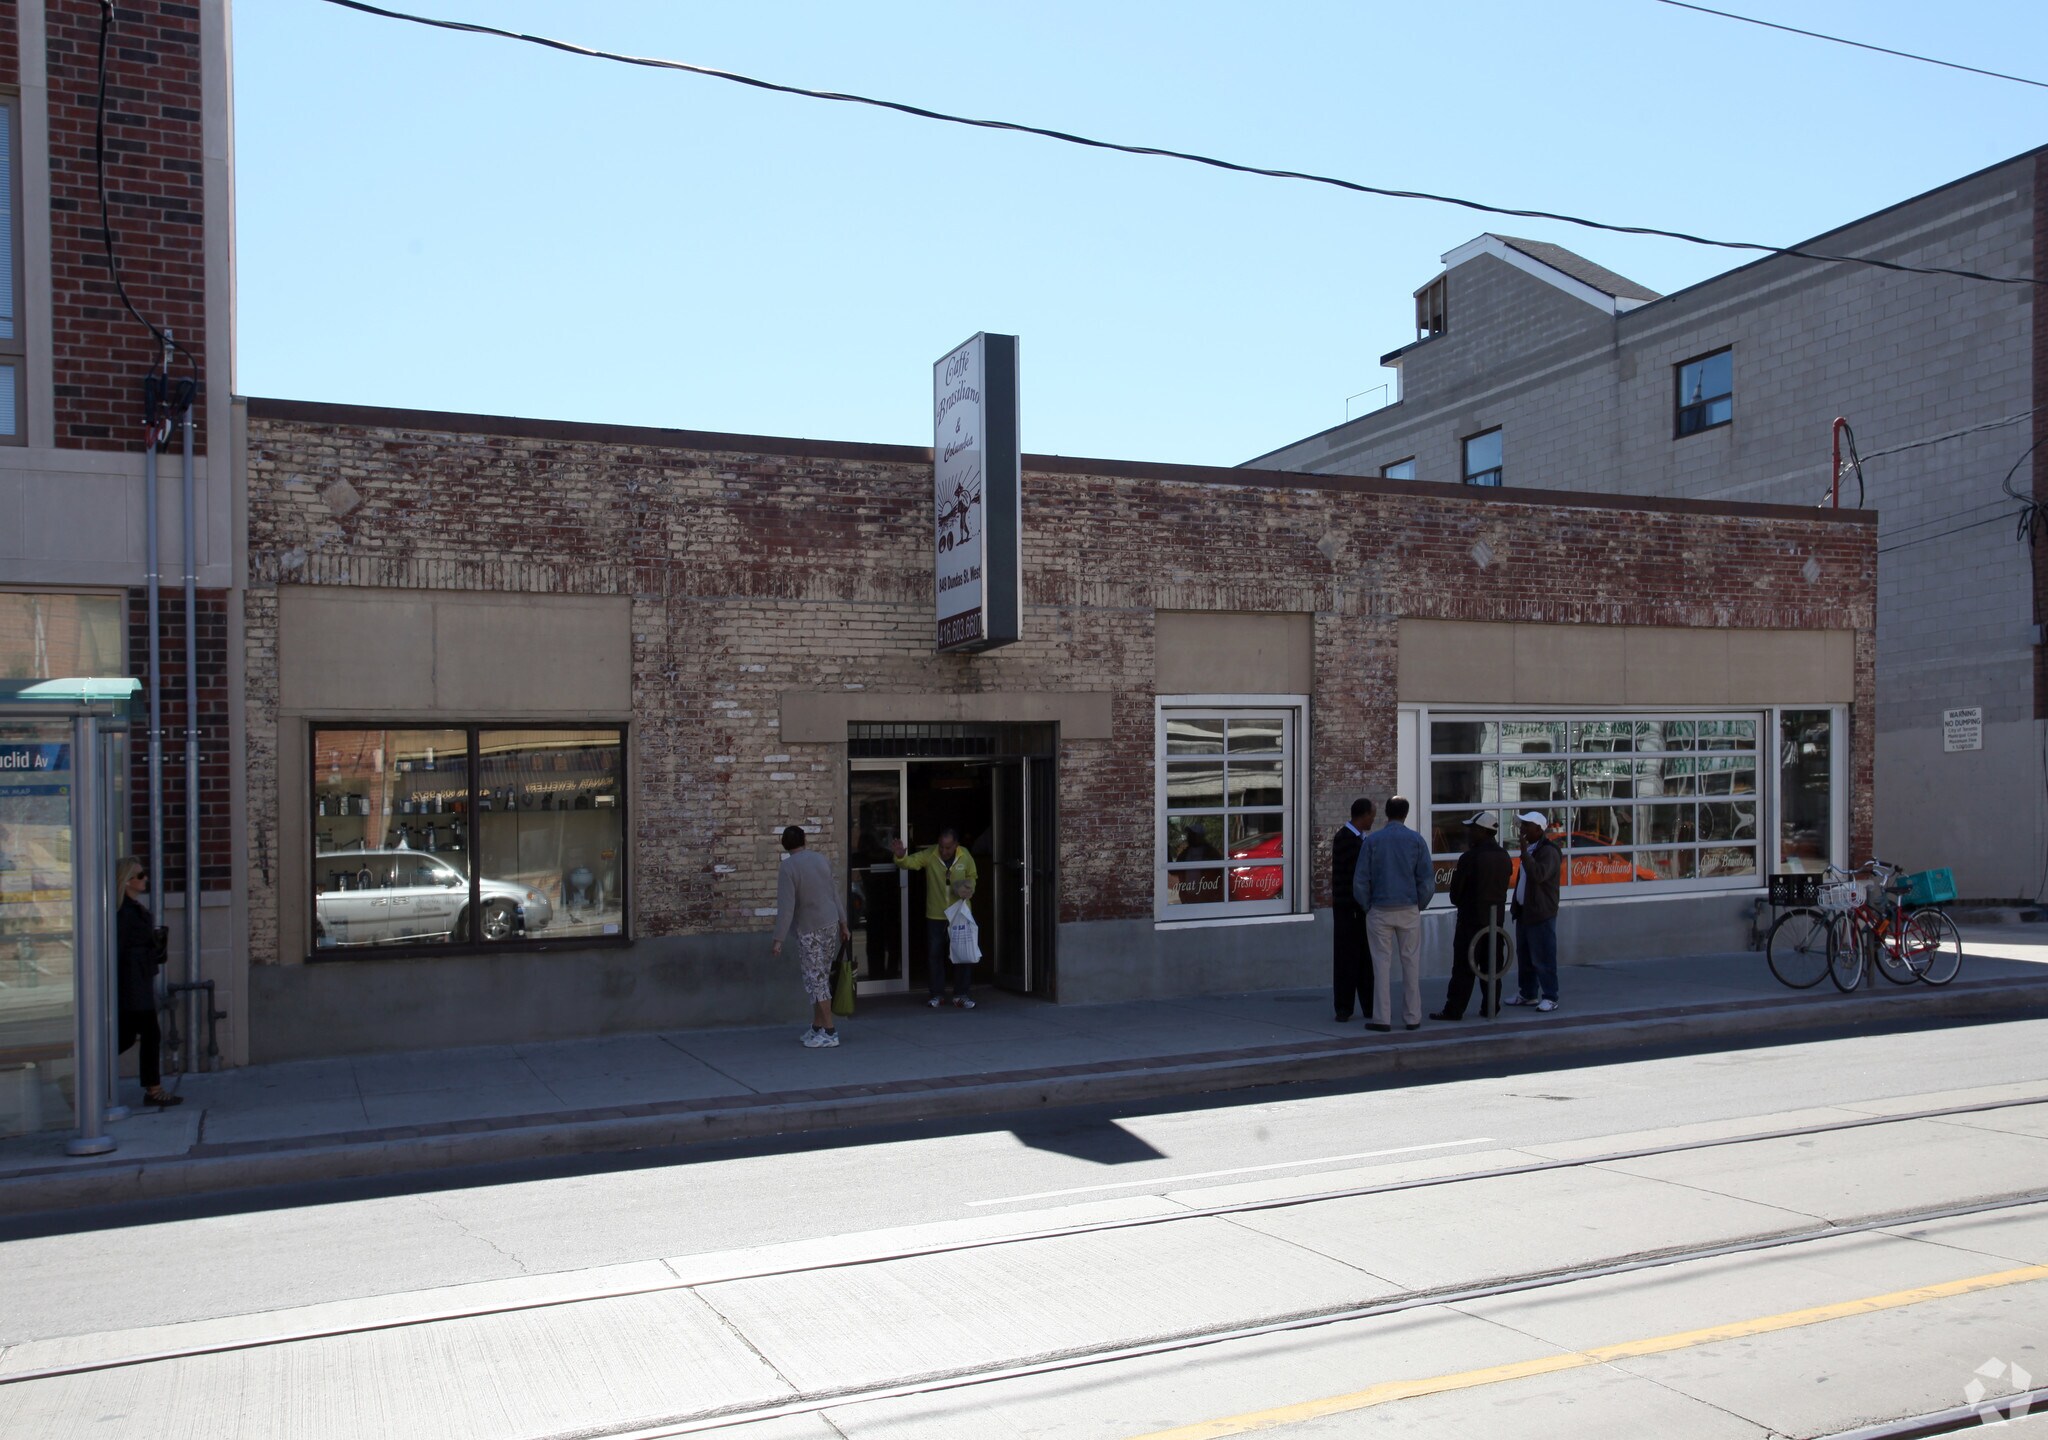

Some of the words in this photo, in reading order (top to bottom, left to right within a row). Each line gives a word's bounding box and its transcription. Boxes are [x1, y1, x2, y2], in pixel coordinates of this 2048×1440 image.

[946, 351, 970, 386] Caffé
[937, 380, 980, 428] Brasiliano
[955, 417, 961, 434] &
[947, 572, 963, 590] Dundas
[970, 564, 981, 582] West
[1949, 709, 1977, 718] WARNING
[1955, 718, 1981, 726] DUMPING
[34, 754, 49, 768] Av
[1434, 865, 1457, 885] Caff
[1595, 859, 1632, 875] Brasiliano
[1172, 880, 1196, 896] great
[1195, 875, 1221, 895] food
[1231, 875, 1254, 894] fresh
[1256, 873, 1280, 892] coffee
